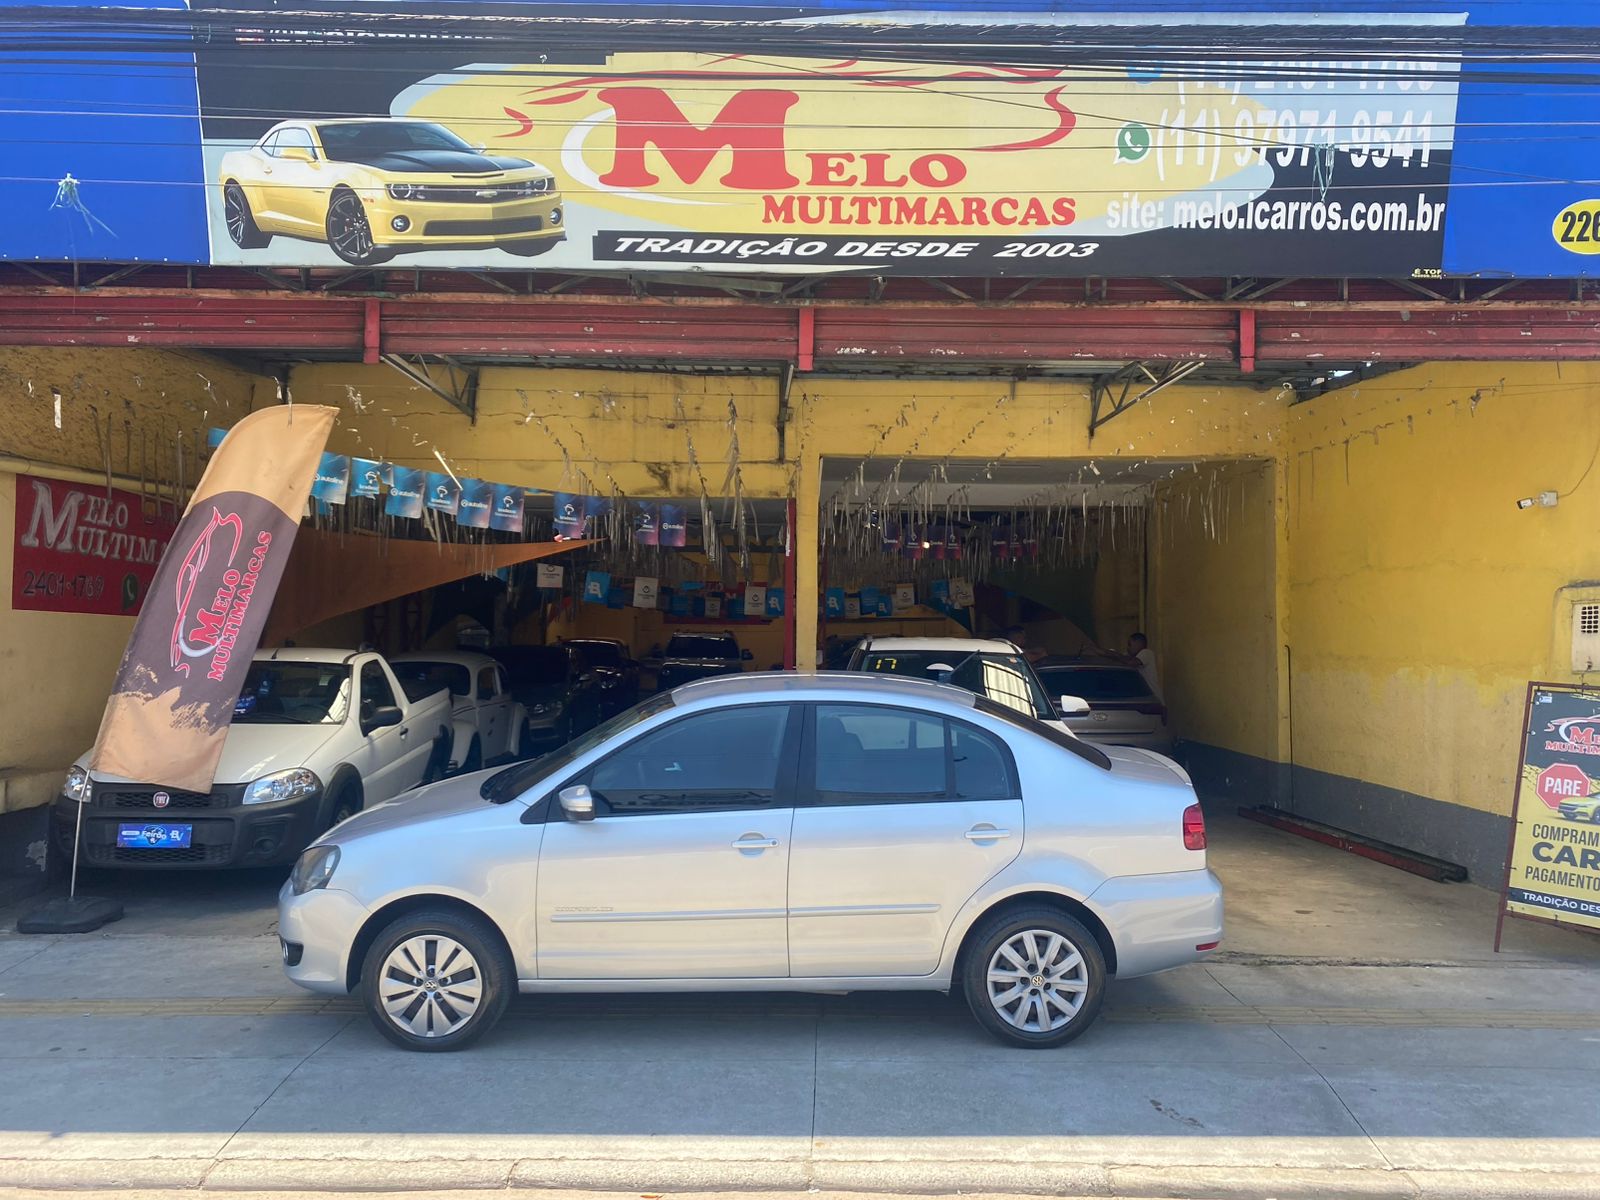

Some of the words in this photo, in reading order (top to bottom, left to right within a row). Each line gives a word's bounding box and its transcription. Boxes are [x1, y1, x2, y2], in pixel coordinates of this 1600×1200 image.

[597, 87, 967, 190] MELO
[1157, 108, 1220, 182] (11)
[1234, 109, 1434, 168] 97971-9541
[762, 194, 1076, 226] MULTIMARCAS
[1106, 193, 1163, 229] site:
[1173, 193, 1445, 231] melo.icarros.com.br
[614, 238, 827, 259] TRADIÇÃO
[834, 242, 980, 258] DESDE
[993, 242, 1099, 258] 2003
[189, 569, 241, 646] MELO
[207, 531, 272, 681] MULTIMARCAS
[1545, 777, 1582, 796] PARE
[1532, 824, 1599, 847] COMPRAM
[1532, 842, 1600, 871] CAR
[1523, 892, 1578, 909] TRADIÇÃO
